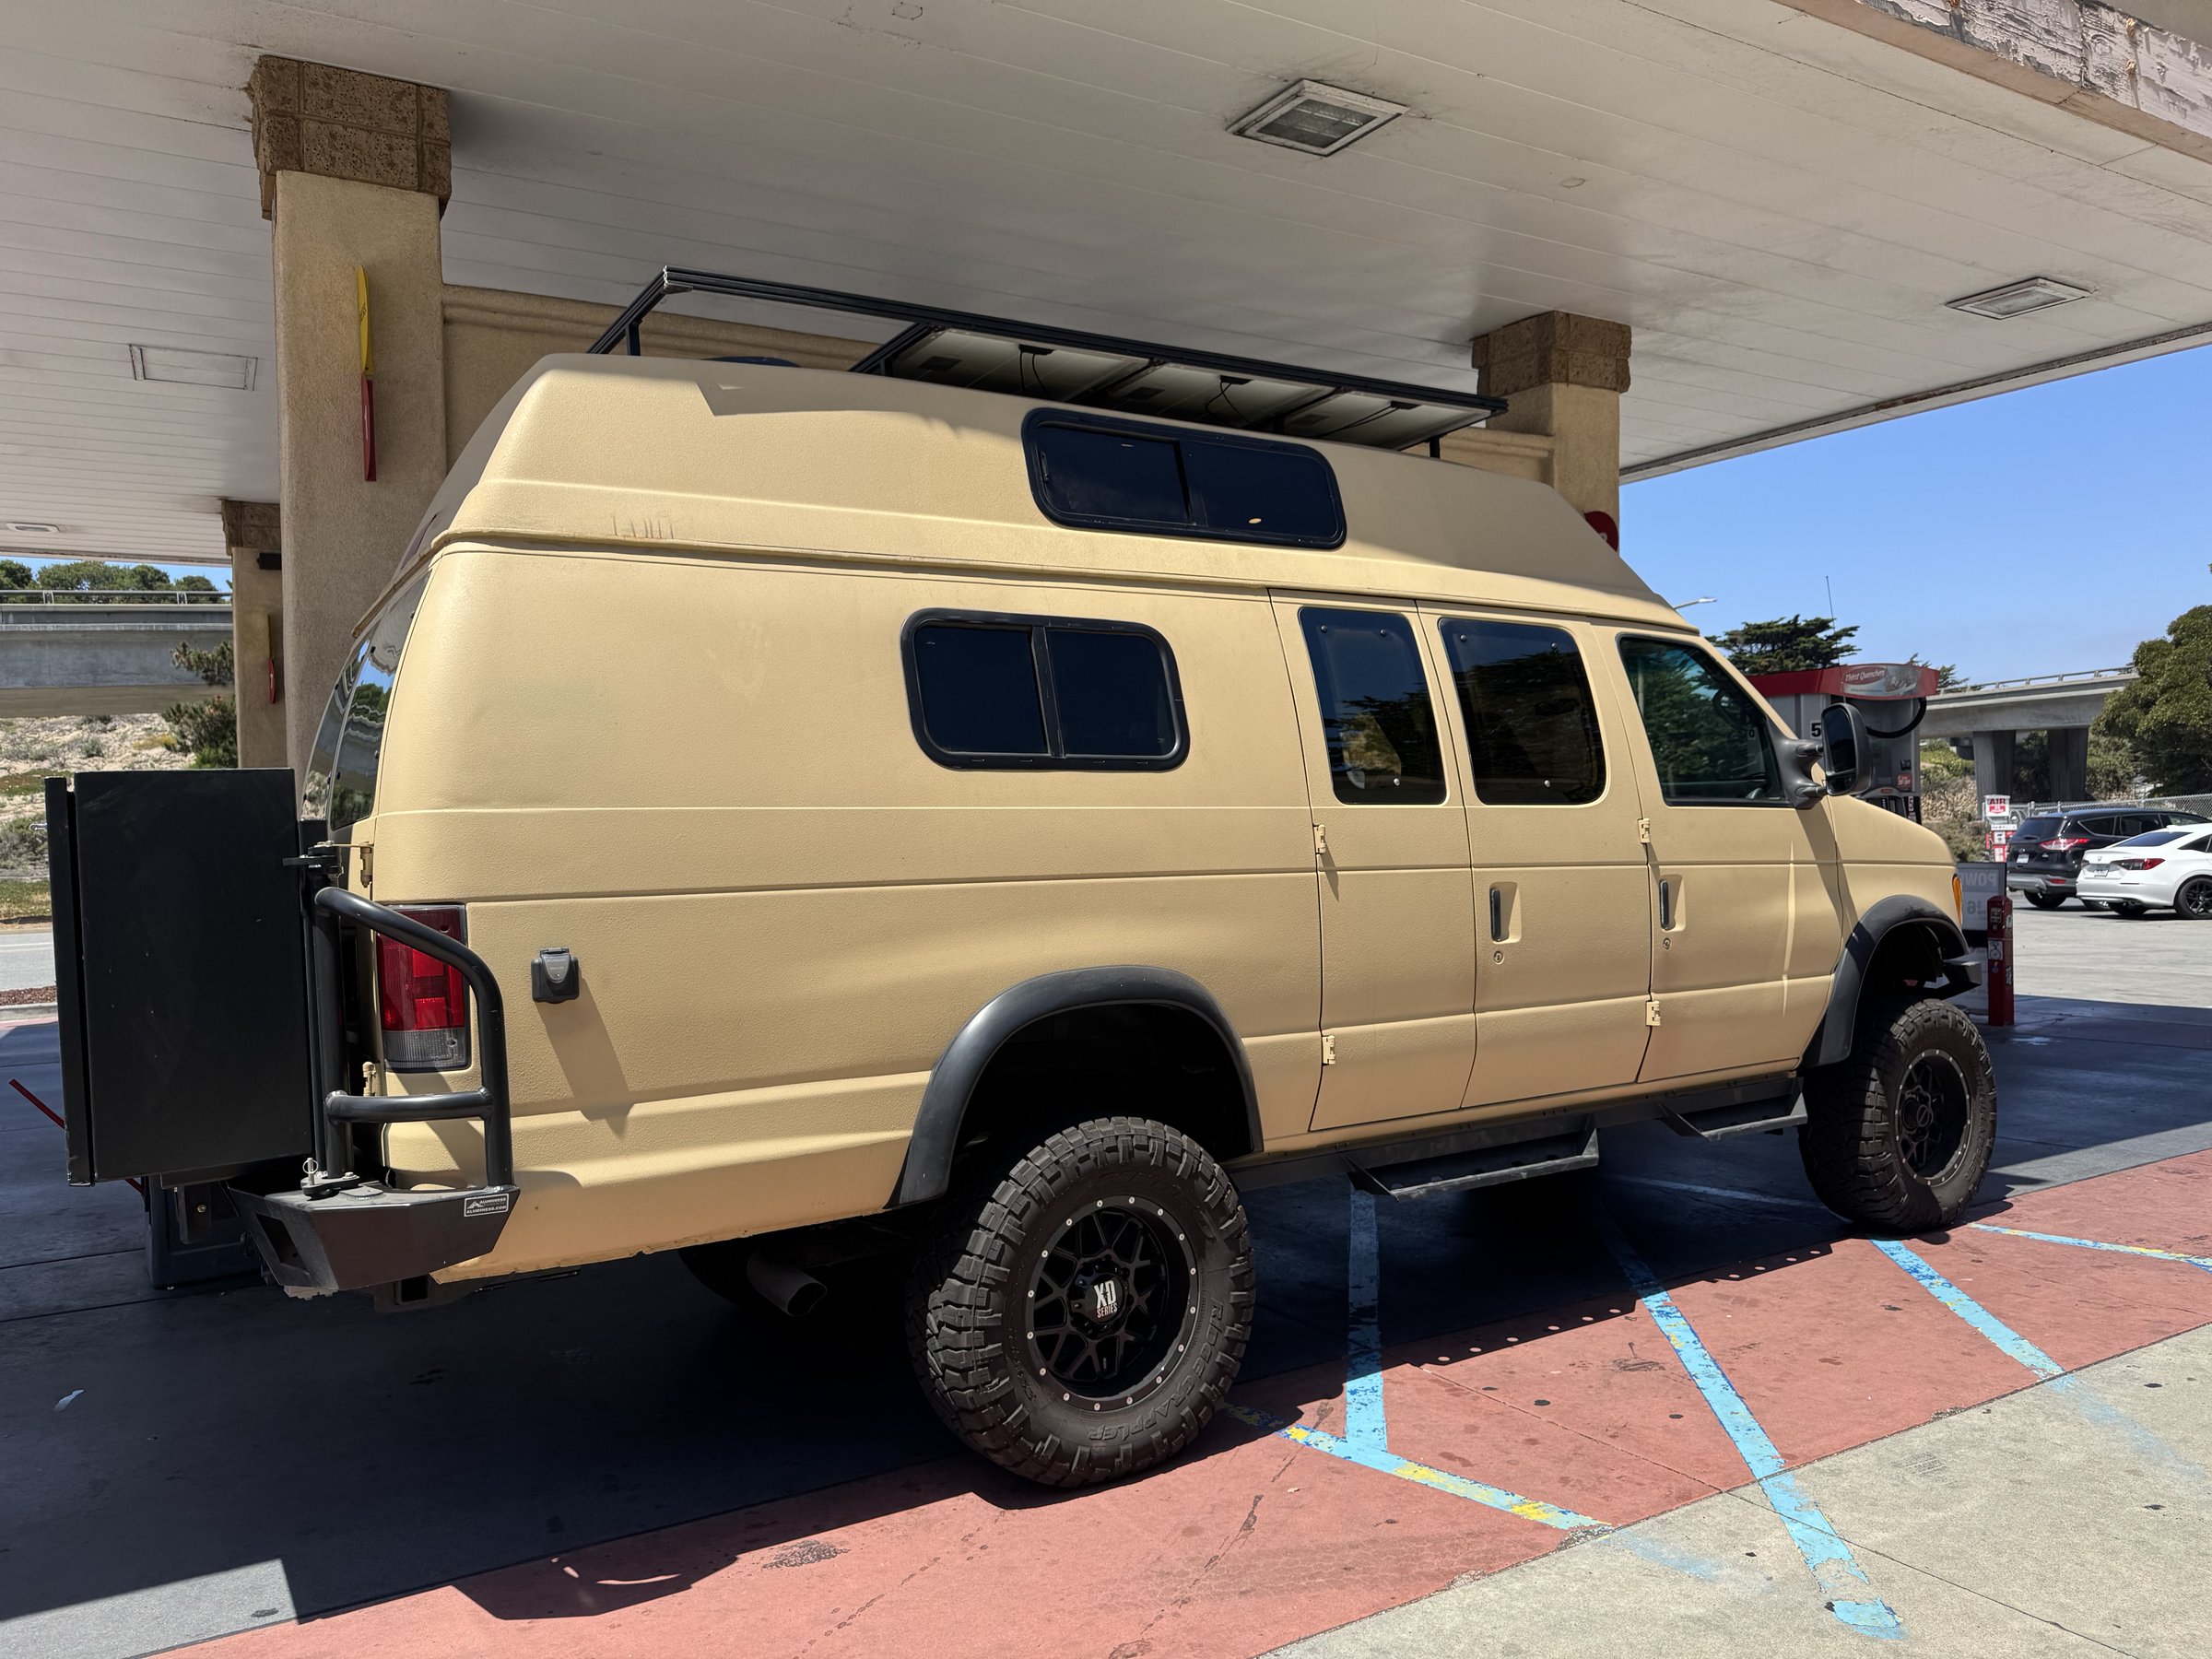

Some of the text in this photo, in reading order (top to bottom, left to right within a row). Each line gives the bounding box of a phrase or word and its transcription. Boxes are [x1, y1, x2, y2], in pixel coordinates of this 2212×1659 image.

[1811, 723, 1821, 737] 5
[466, 1205, 506, 1214] ALUMINESS.COM
[1093, 1280, 1117, 1309] XD
[1097, 1302, 1118, 1319] SERIES
[1193, 1297, 1224, 1377] RIDGE
[1088, 1374, 1195, 1441] GRAPPLER
